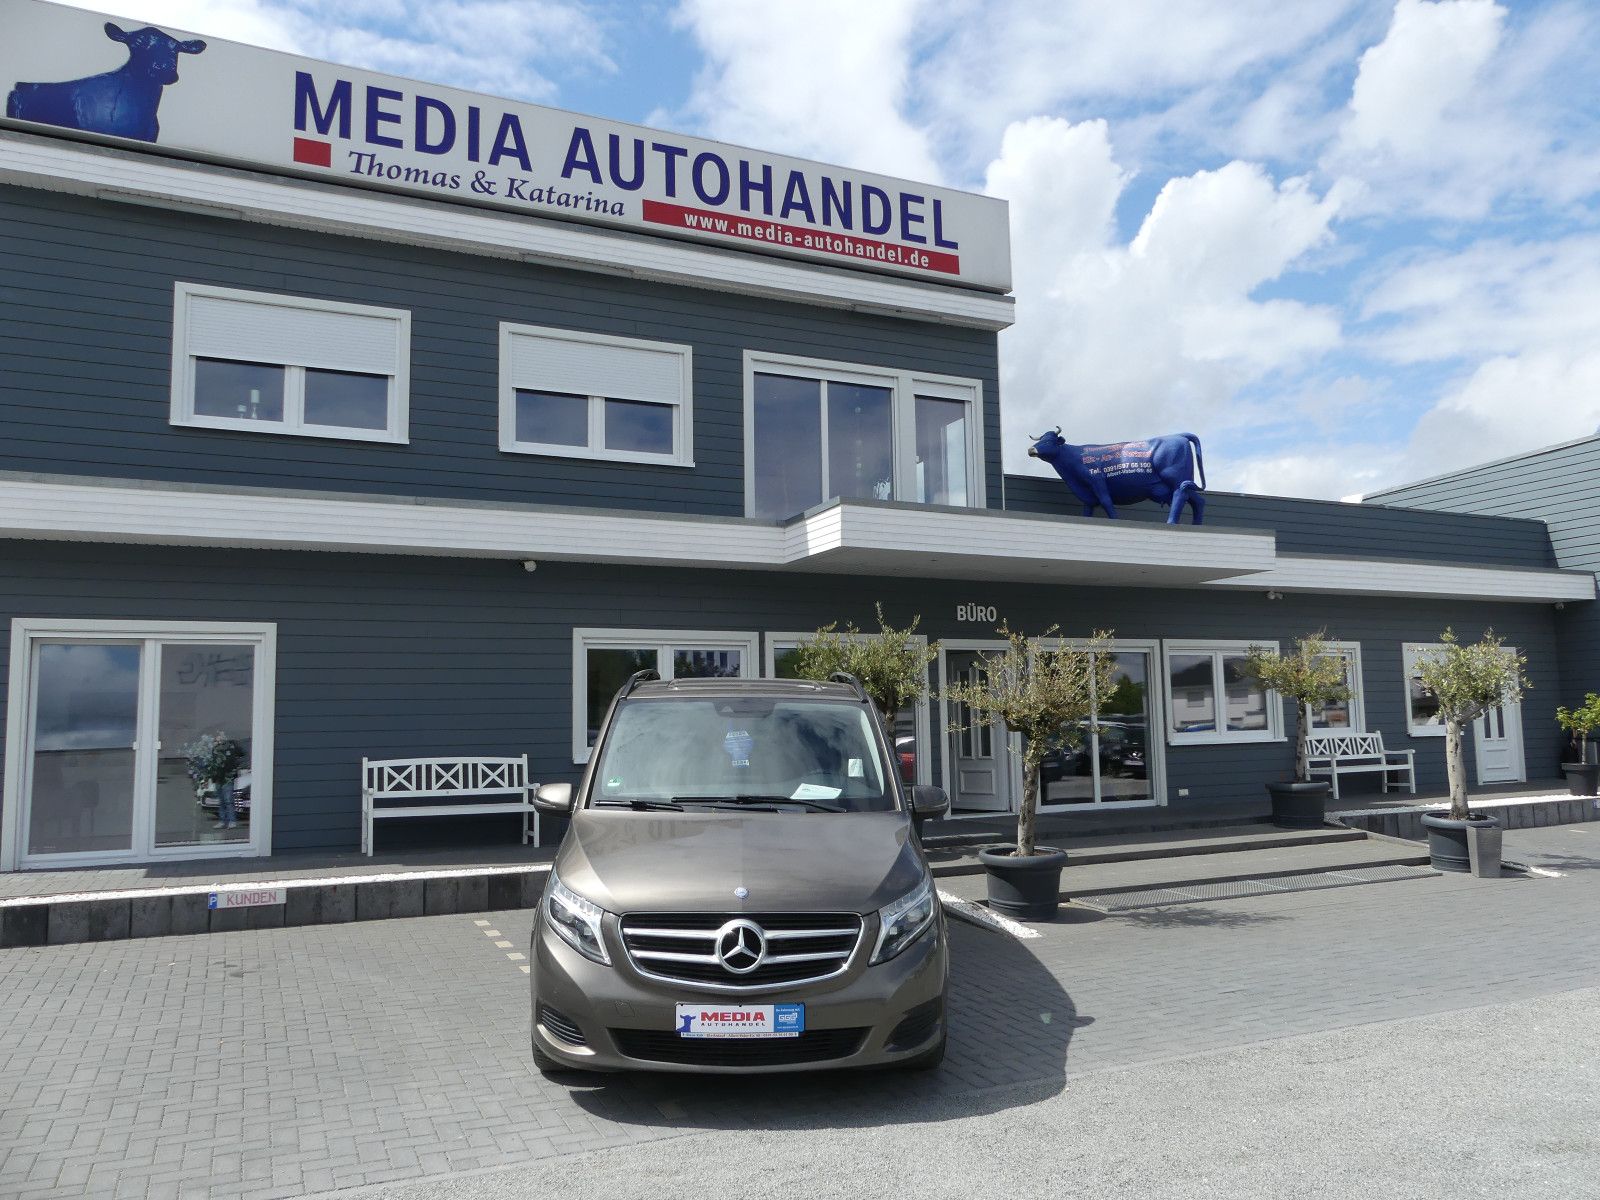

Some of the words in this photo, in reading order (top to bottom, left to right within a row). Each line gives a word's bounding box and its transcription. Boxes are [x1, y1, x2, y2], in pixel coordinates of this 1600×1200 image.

[294, 71, 533, 173] MEDIA
[561, 126, 959, 250] AUTOHANDEL
[348, 150, 462, 190] Thomas
[470, 170, 497, 196] &
[505, 177, 626, 217] Katarina
[684, 212, 930, 269] www.media-autohandel.de
[956, 602, 997, 622] BÜRO
[226, 891, 277, 906] KUNDEN
[700, 1011, 766, 1022] MEDIA
